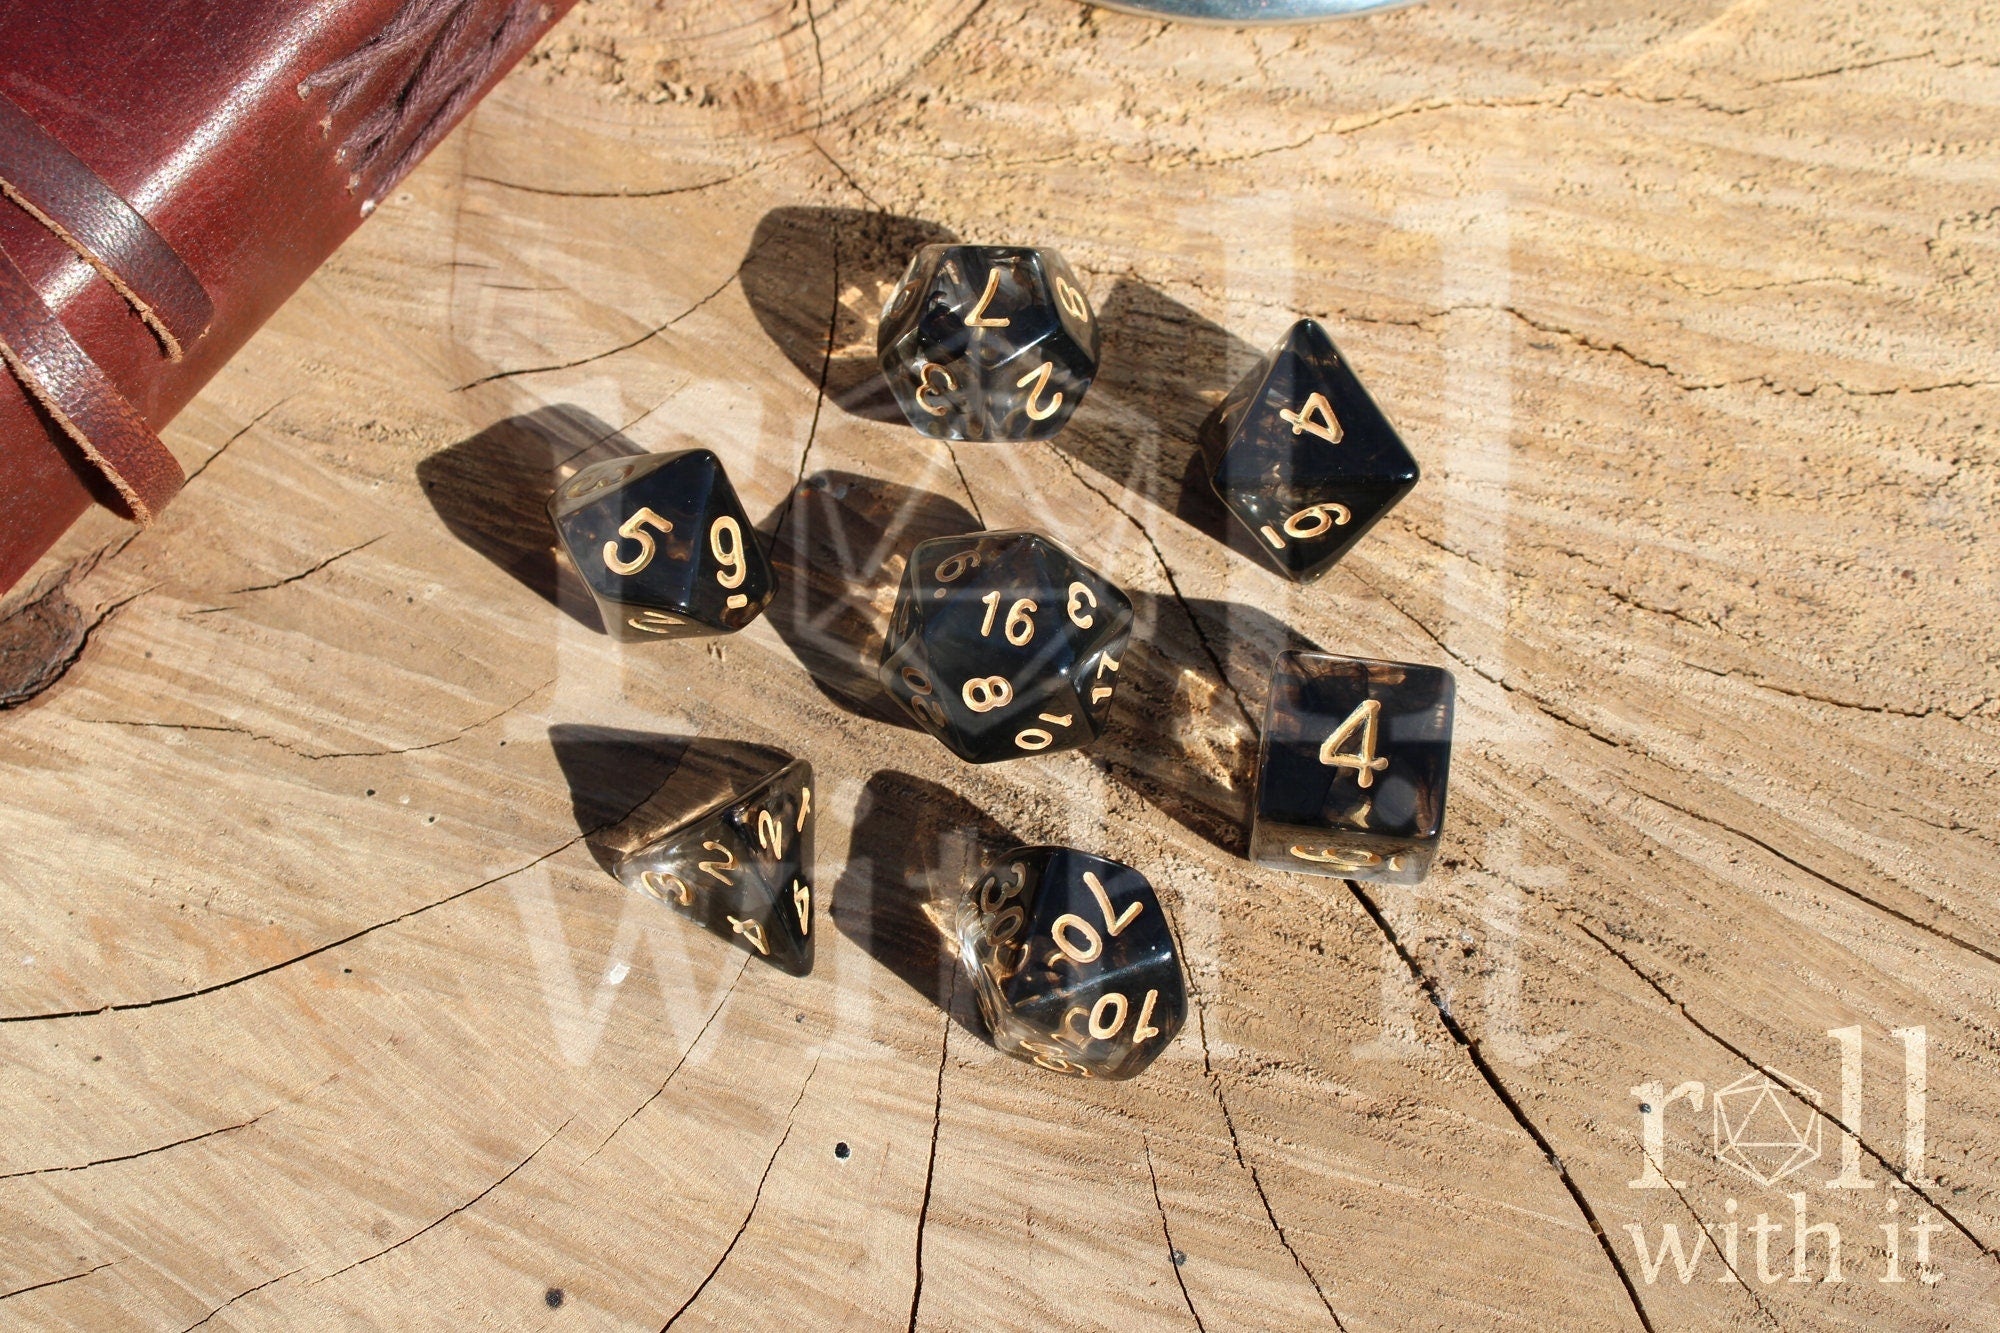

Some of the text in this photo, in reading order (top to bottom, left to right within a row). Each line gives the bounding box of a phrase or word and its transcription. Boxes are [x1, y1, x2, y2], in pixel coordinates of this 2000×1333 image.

[964, 267, 1011, 327] 7
[1055, 276, 1089, 323] 8
[915, 362, 958, 416] 3
[1016, 361, 1064, 421] 2
[1279, 391, 1344, 444] 4
[602, 506, 674, 576] 5
[982, 590, 1038, 647] 16
[1067, 581, 1098, 629] 3
[962, 675, 1014, 713] 8
[1014, 712, 1073, 751] 10
[1319, 699, 1389, 788] 4
[758, 809, 782, 861] 2
[640, 870, 693, 907] 3
[698, 840, 737, 887] 2
[793, 879, 810, 936] 4
[1050, 870, 1145, 964] 70
[727, 914, 771, 956] 4
[1088, 989, 1160, 1044] 10
